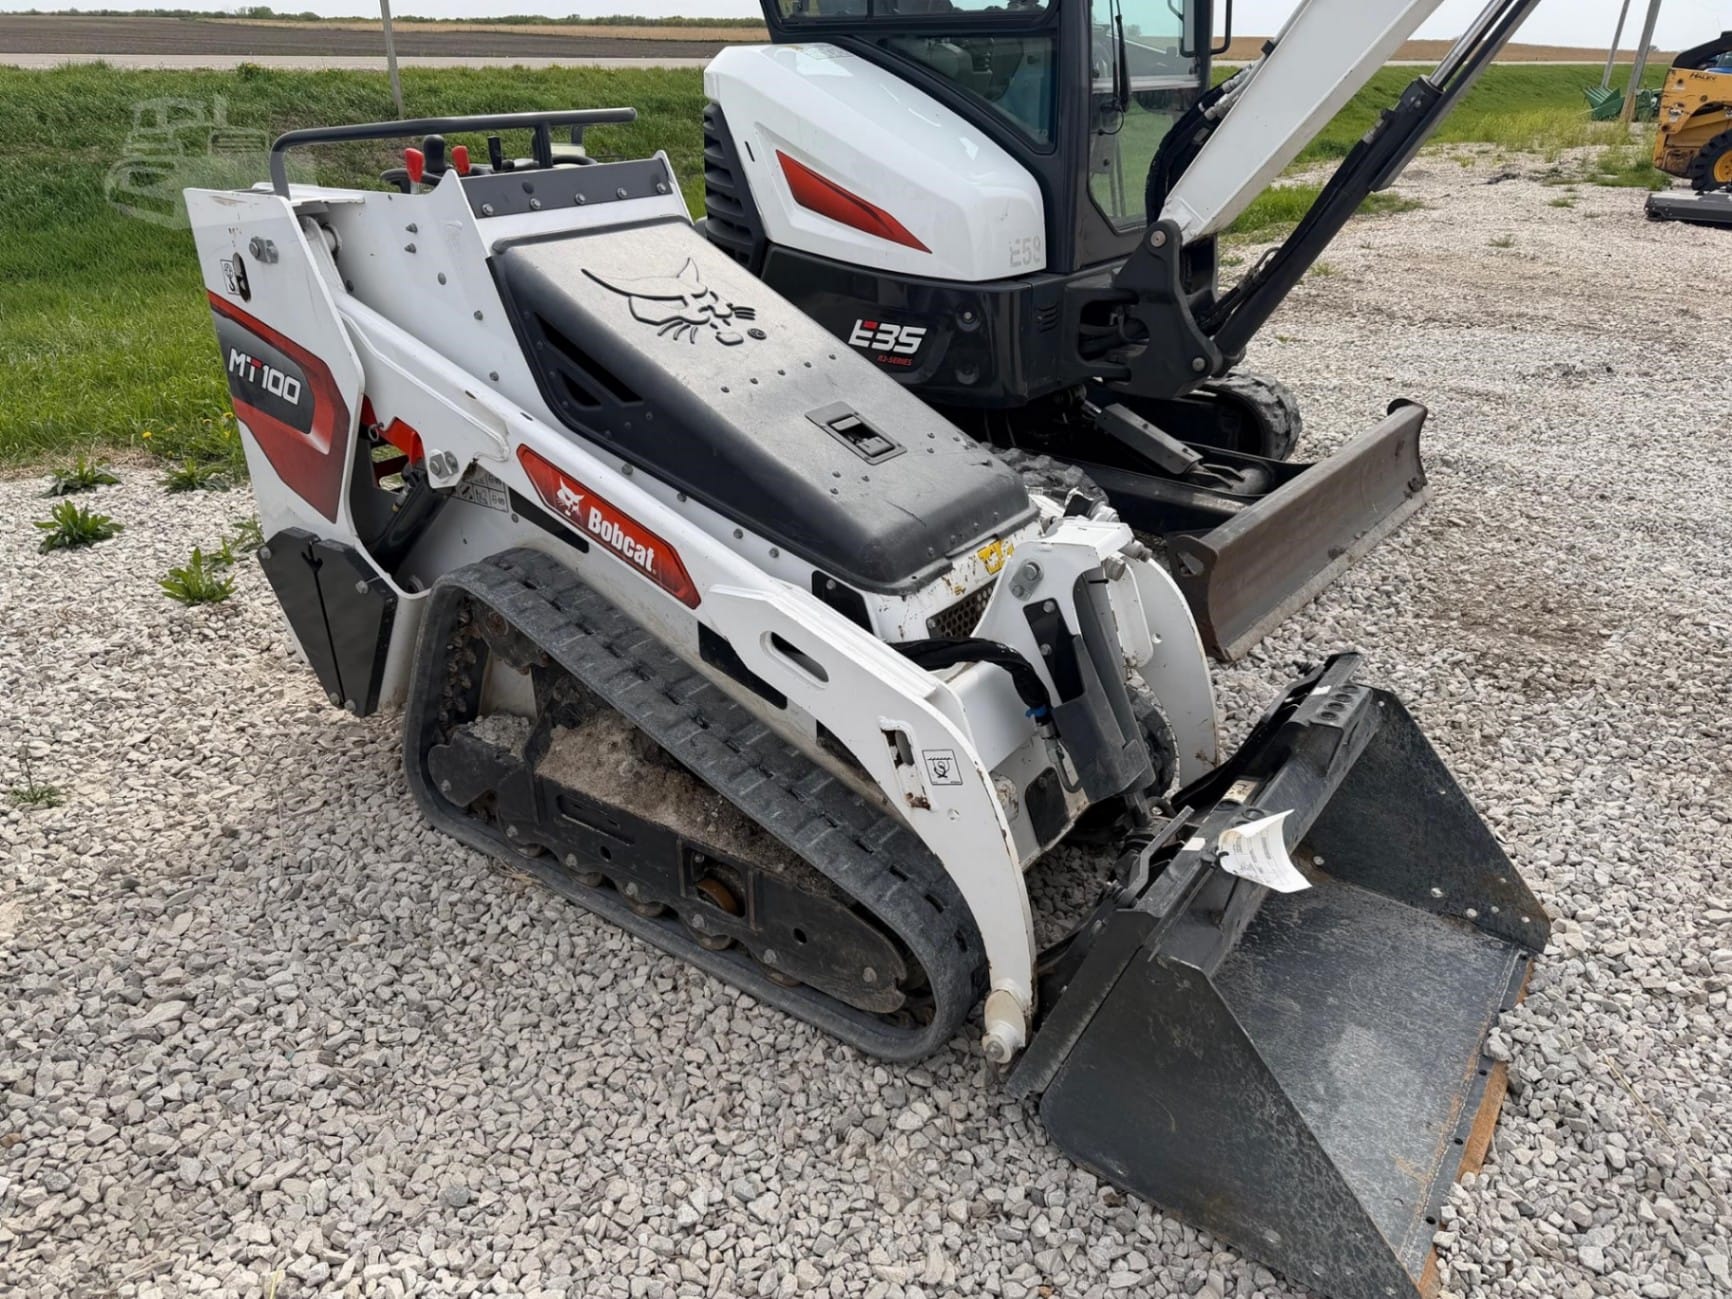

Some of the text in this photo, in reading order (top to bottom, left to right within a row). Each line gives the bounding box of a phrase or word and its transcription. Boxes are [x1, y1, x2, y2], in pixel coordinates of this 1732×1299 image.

[847, 319, 927, 354] E35
[228, 348, 302, 405] MT100
[588, 506, 655, 574] Bobcat
